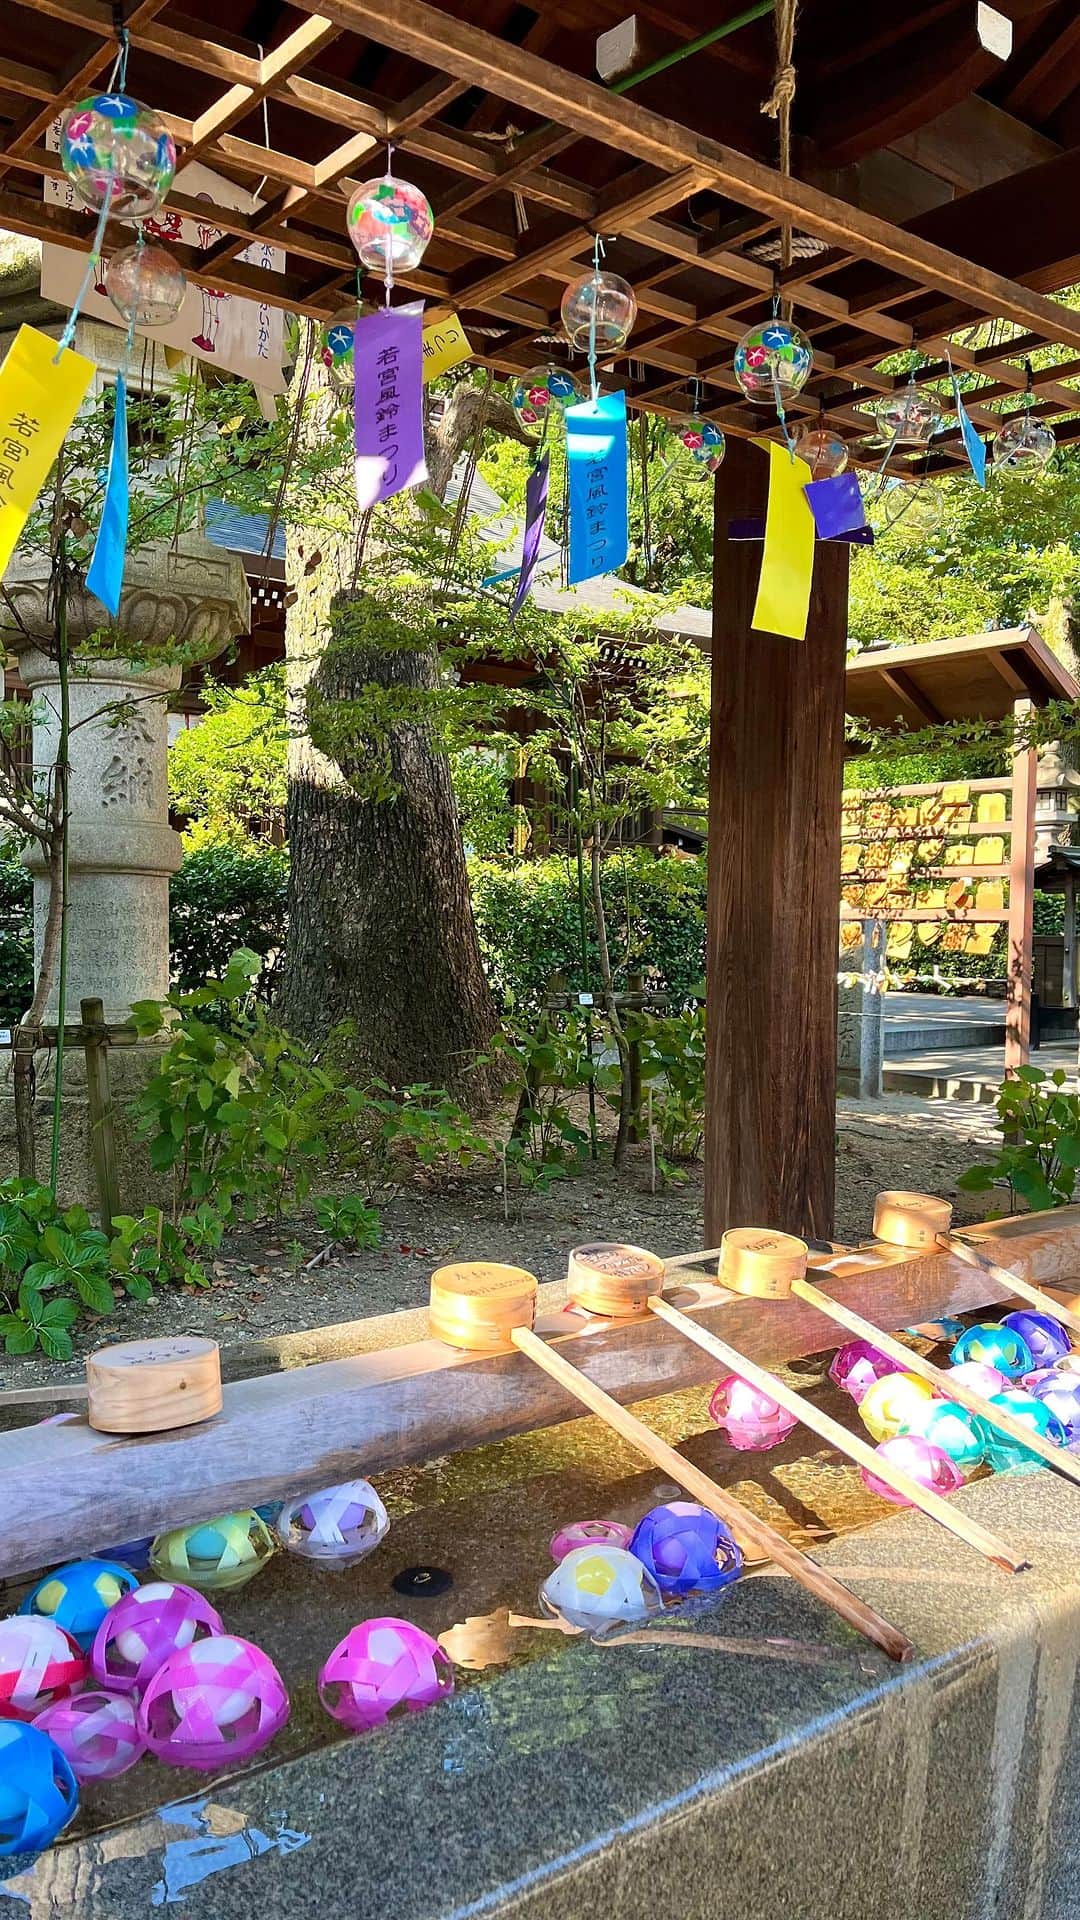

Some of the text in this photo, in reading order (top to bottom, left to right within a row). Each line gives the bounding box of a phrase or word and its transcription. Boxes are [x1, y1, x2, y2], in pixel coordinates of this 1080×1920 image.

[0, 411, 40, 508] 若宮風
[375, 345, 401, 486] 若宮風鈴まつり
